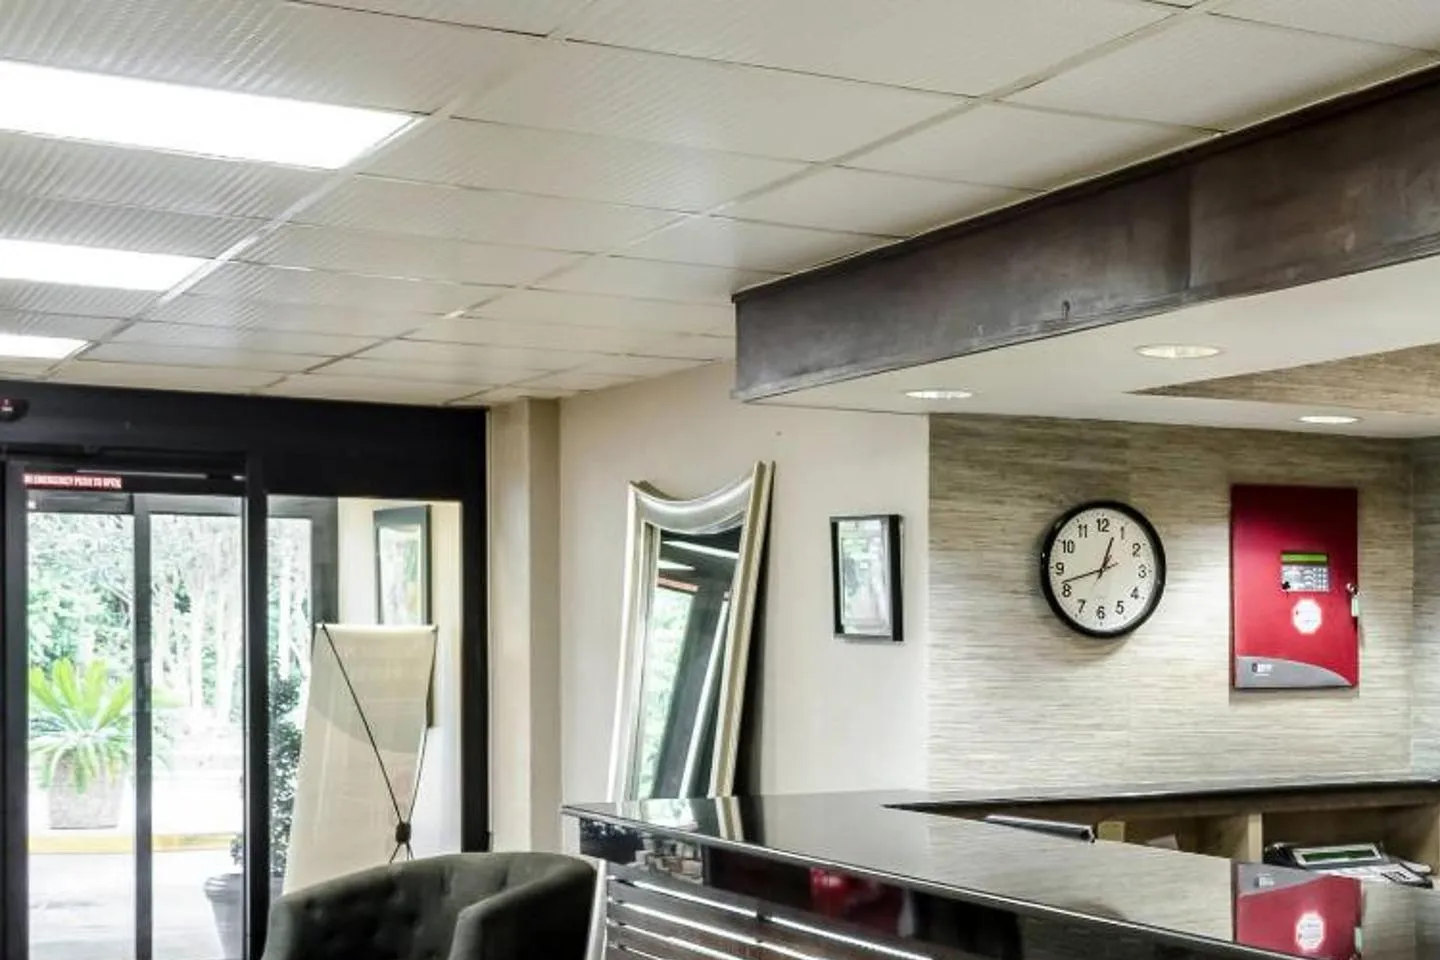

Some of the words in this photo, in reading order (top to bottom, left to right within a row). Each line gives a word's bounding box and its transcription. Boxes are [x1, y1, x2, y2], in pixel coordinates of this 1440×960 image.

[1078, 524, 1088, 538] 11
[1096, 518, 1110, 532] 12
[1120, 526, 1125, 540] 1
[1062, 540, 1075, 553] 10
[1132, 543, 1142, 557] 2
[1055, 562, 1064, 576] 9
[1138, 564, 1147, 578] 3
[1062, 583, 1072, 598] 8
[1130, 586, 1139, 600] 4
[1077, 599, 1087, 614] 7
[1096, 606, 1105, 620] 6
[1115, 600, 1125, 615] 5
